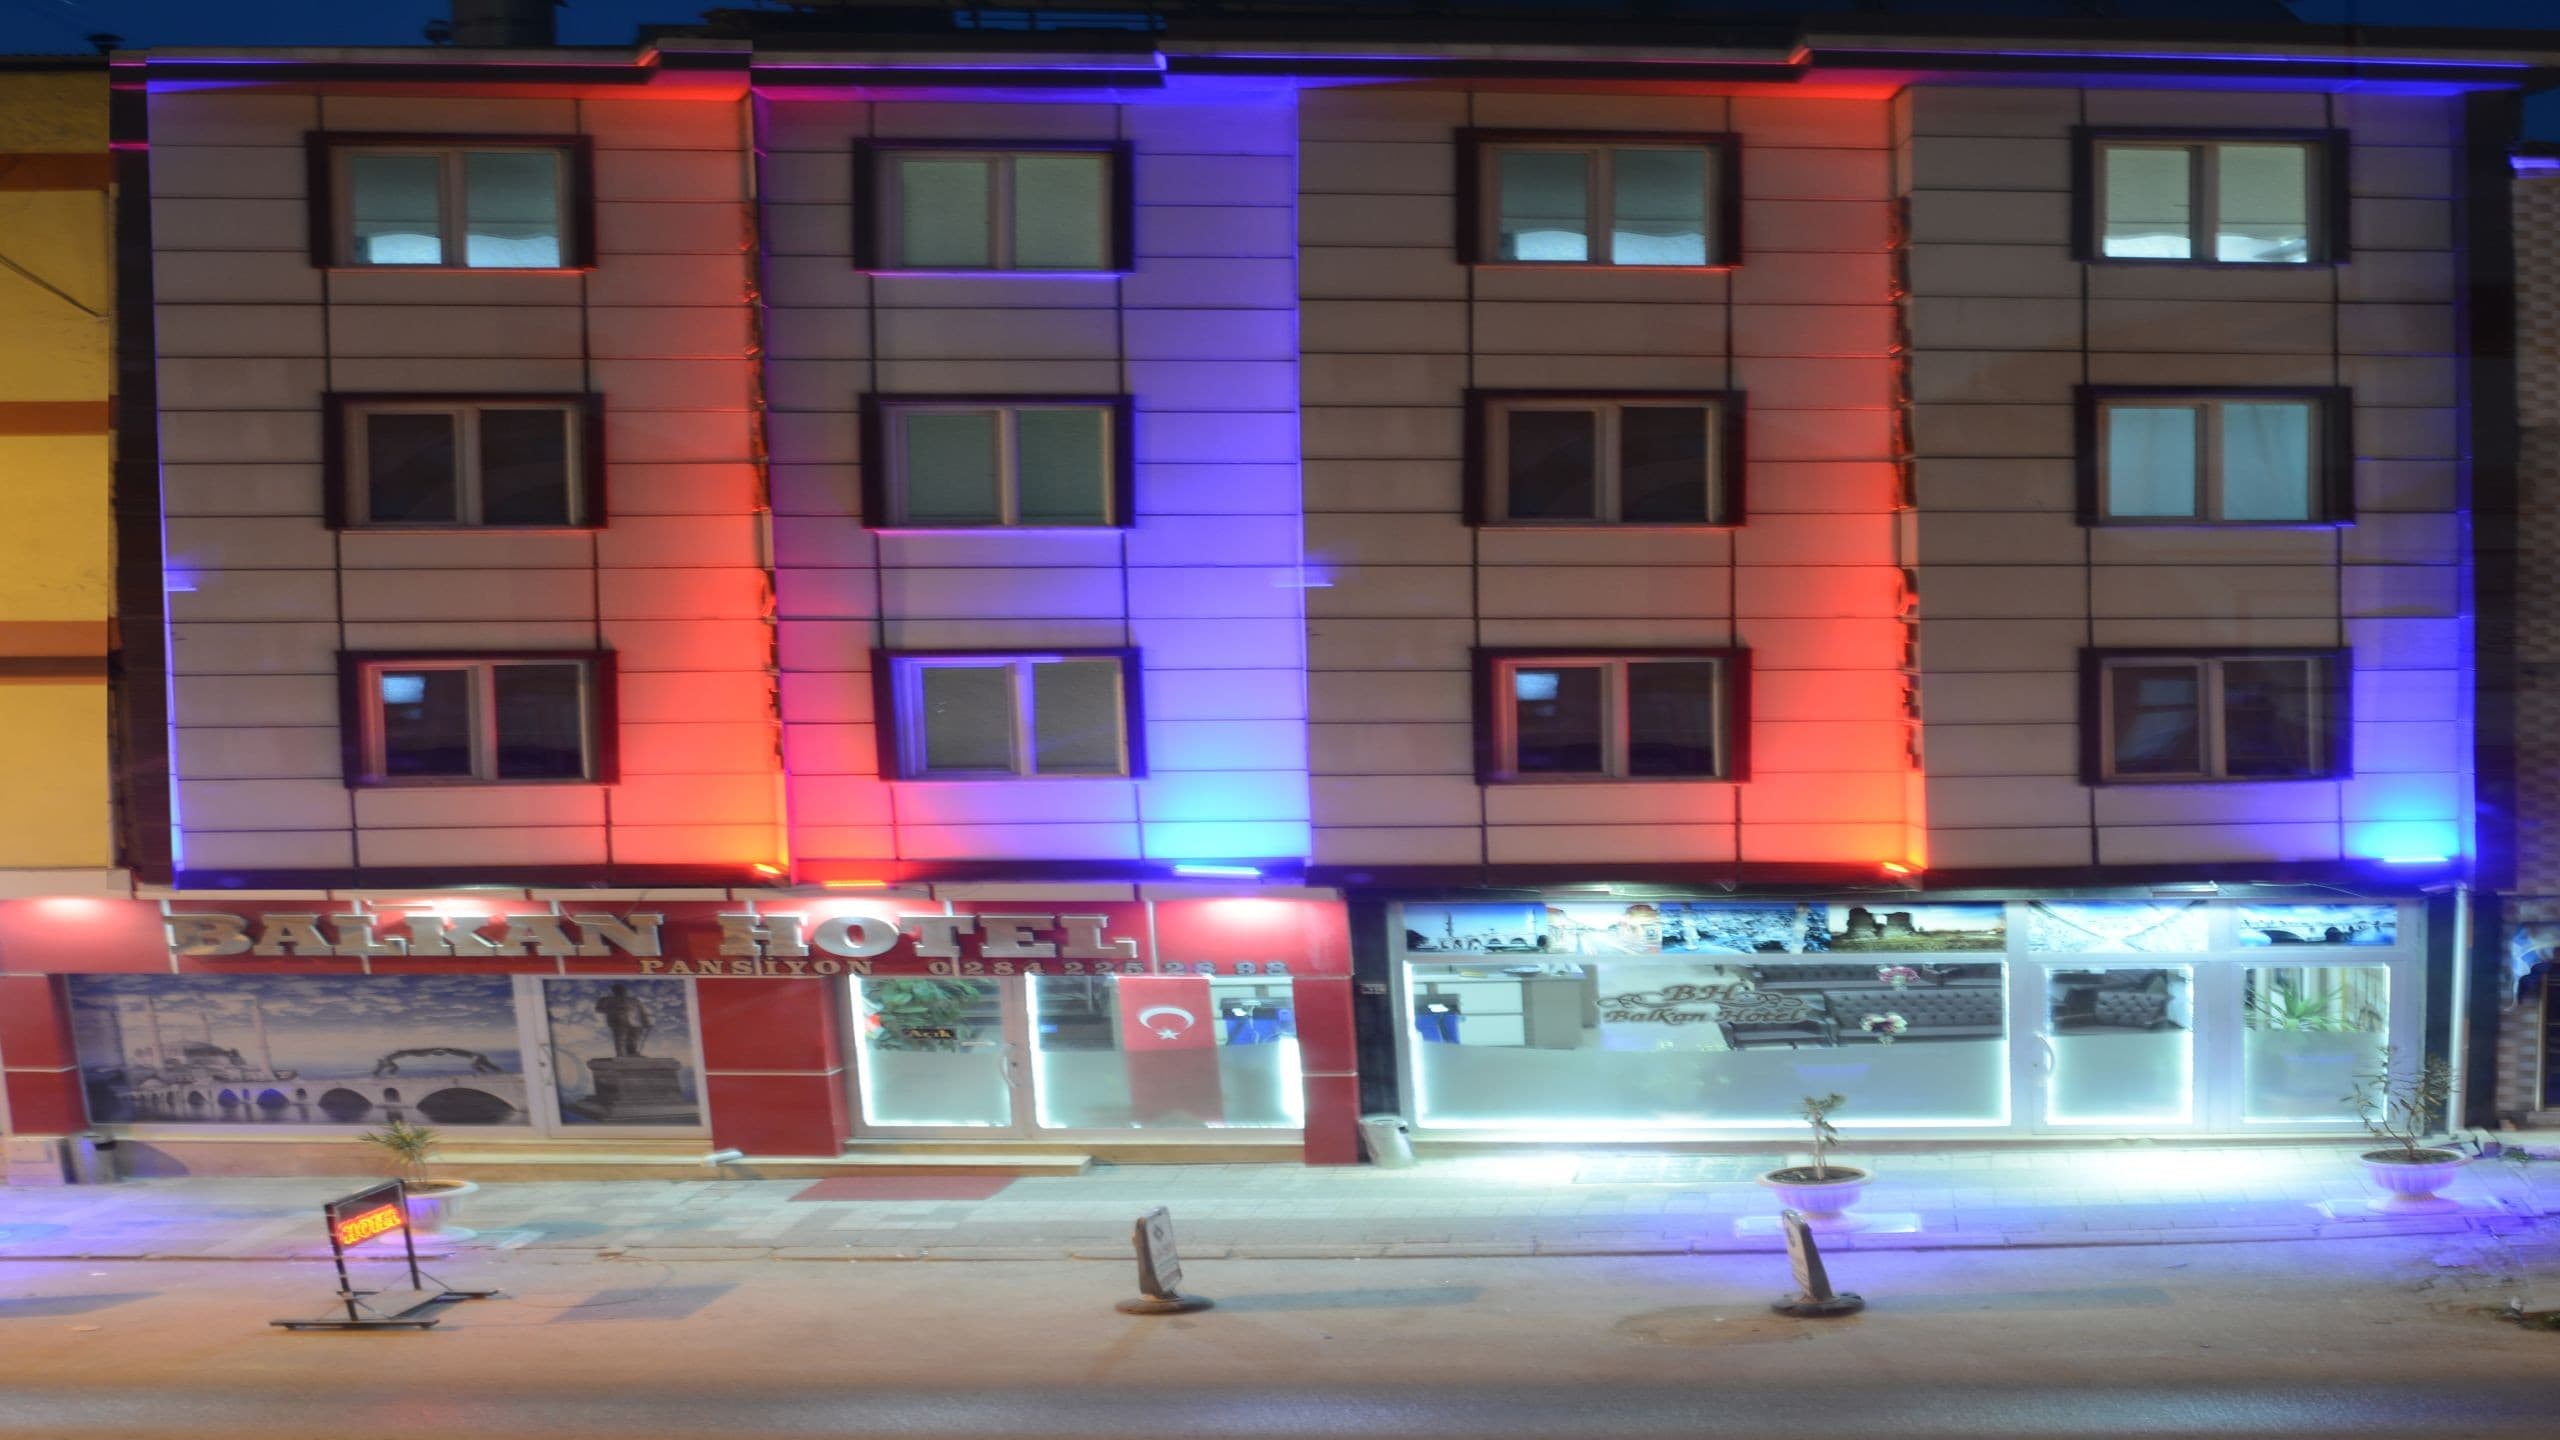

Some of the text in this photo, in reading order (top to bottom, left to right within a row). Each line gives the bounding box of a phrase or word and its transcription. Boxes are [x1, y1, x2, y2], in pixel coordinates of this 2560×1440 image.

[165, 913, 1138, 958] BALKAN HOTEL
[639, 956, 873, 975] PANSİYON
[928, 961, 1045, 976] 0284
[1063, 961, 1146, 976] 225
[1662, 983, 1746, 1001] BH
[1718, 1007, 1808, 1023] Hotel
